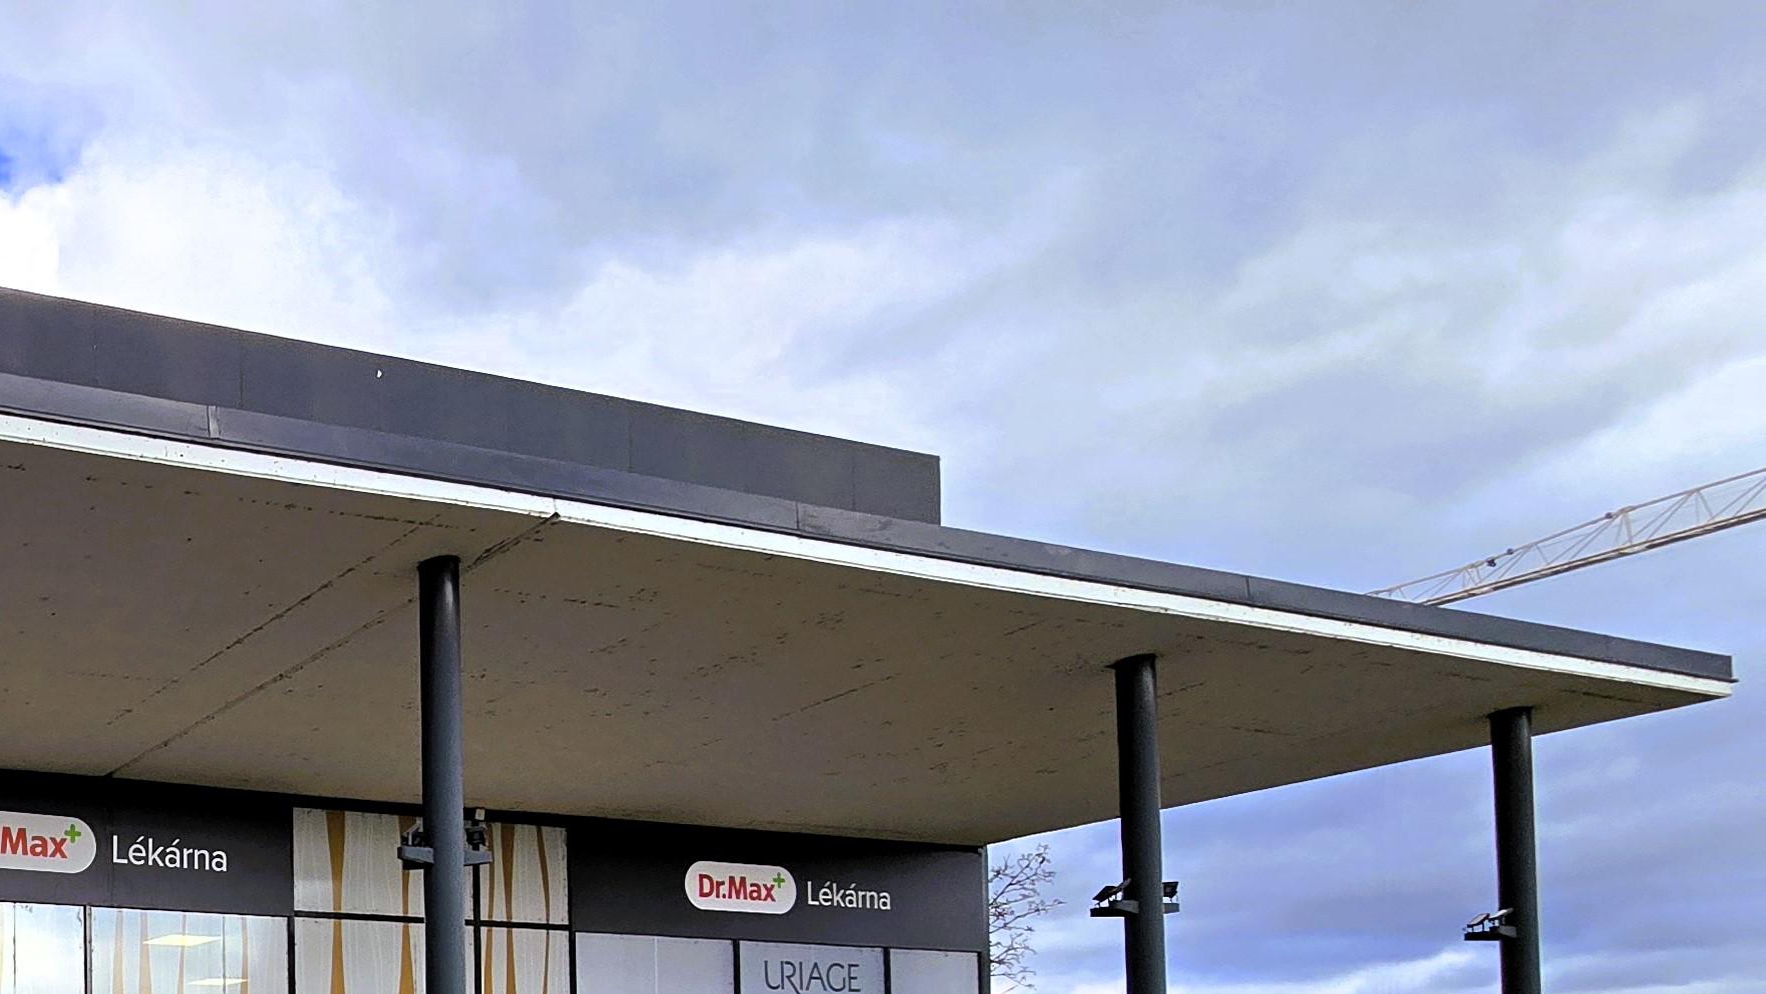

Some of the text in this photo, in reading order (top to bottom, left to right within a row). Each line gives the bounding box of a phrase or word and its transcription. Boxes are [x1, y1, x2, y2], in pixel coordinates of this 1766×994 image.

[112, 835, 228, 872] Lékárna
[698, 873, 892, 910] Dr.Max Lékárna
